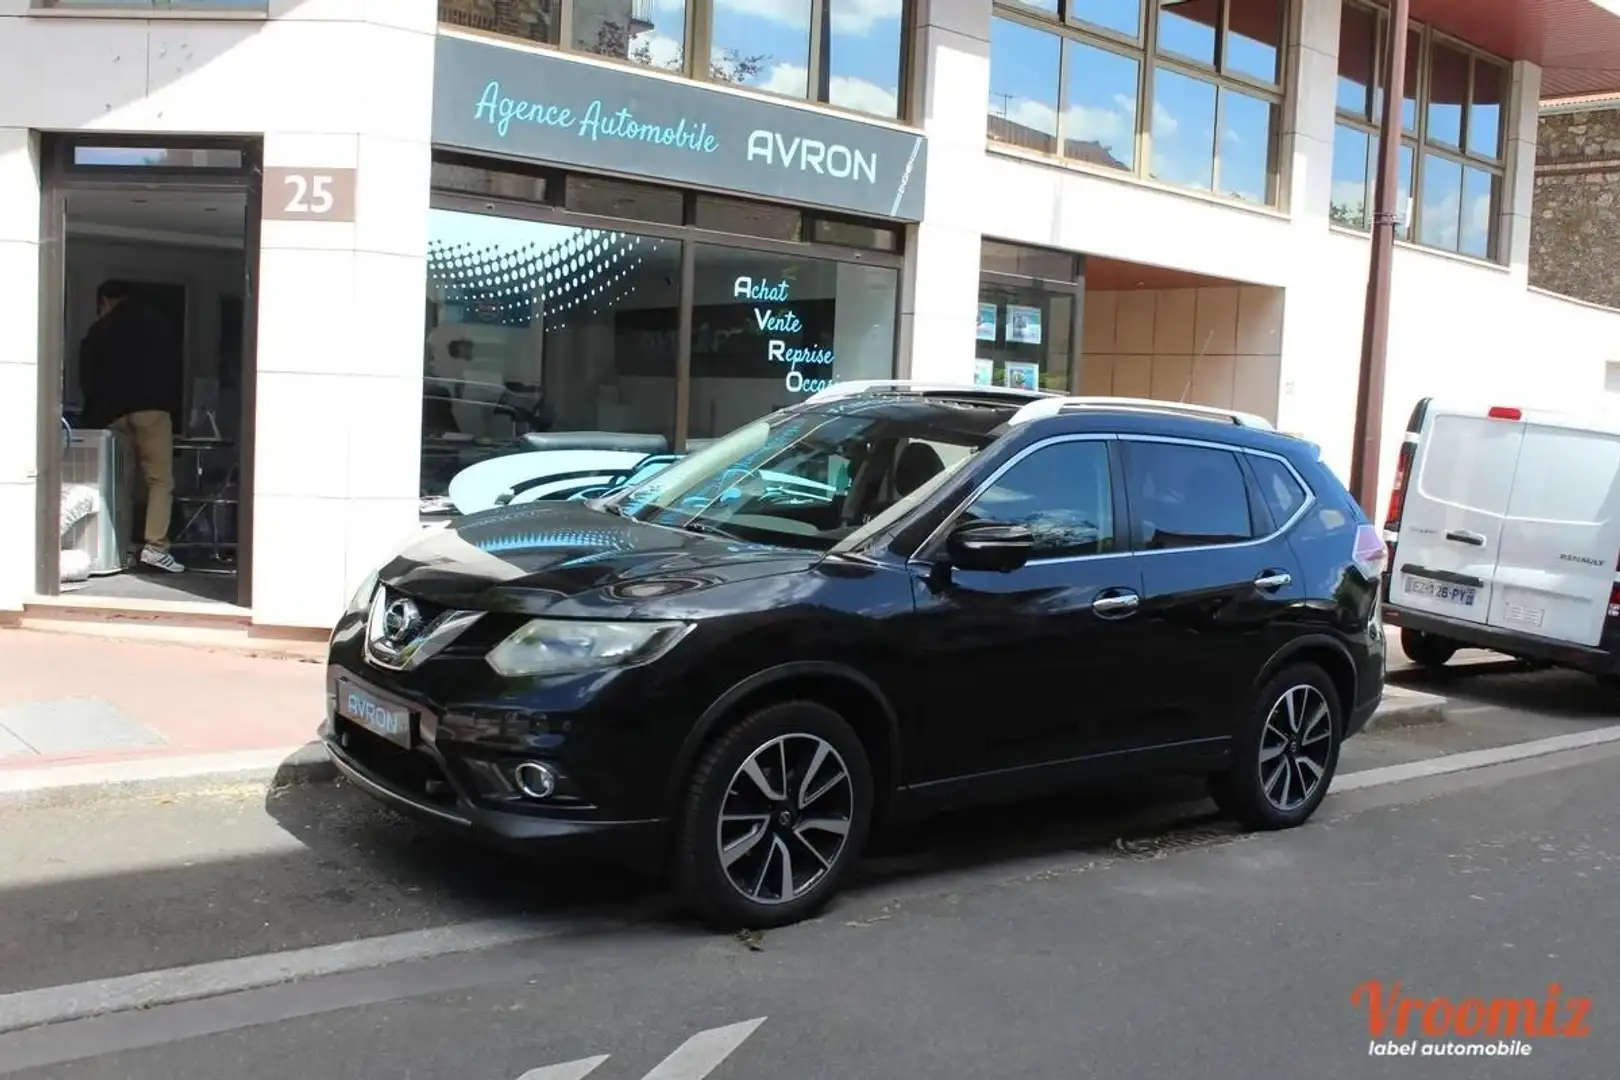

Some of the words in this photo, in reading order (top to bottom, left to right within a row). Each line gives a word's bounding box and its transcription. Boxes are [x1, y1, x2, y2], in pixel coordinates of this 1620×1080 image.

[474, 79, 576, 137] Agence
[578, 100, 719, 153] Automobile
[747, 129, 878, 185] AVRON
[283, 174, 334, 213] 25
[734, 276, 790, 302] Achat
[754, 307, 803, 332] Vente
[768, 340, 834, 371] Reprise
[348, 693, 398, 734] AVRON
